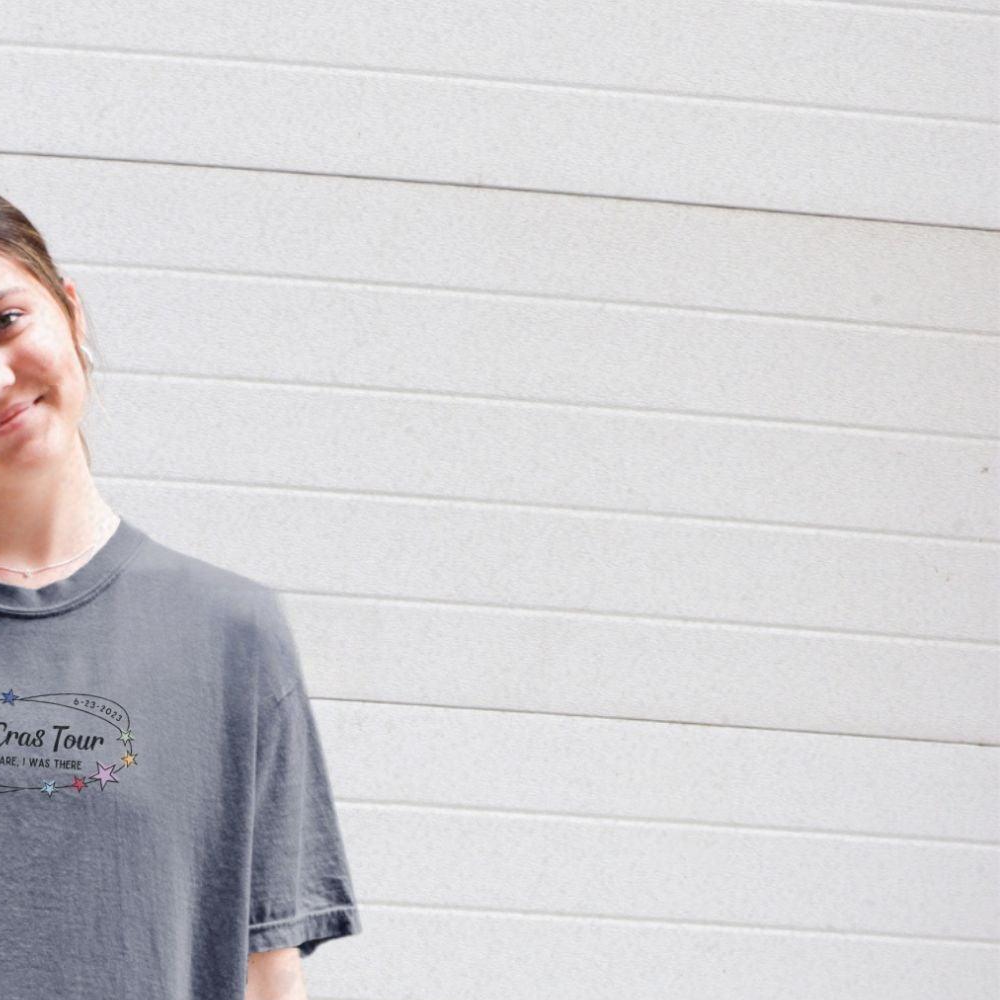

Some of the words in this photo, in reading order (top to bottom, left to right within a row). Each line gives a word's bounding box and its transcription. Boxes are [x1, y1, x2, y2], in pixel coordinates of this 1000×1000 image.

[73, 697, 123, 722] 6-23-2023
[53, 725, 104, 752] Tour
[29, 757, 50, 767] WAS
[54, 758, 83, 770] THERE
